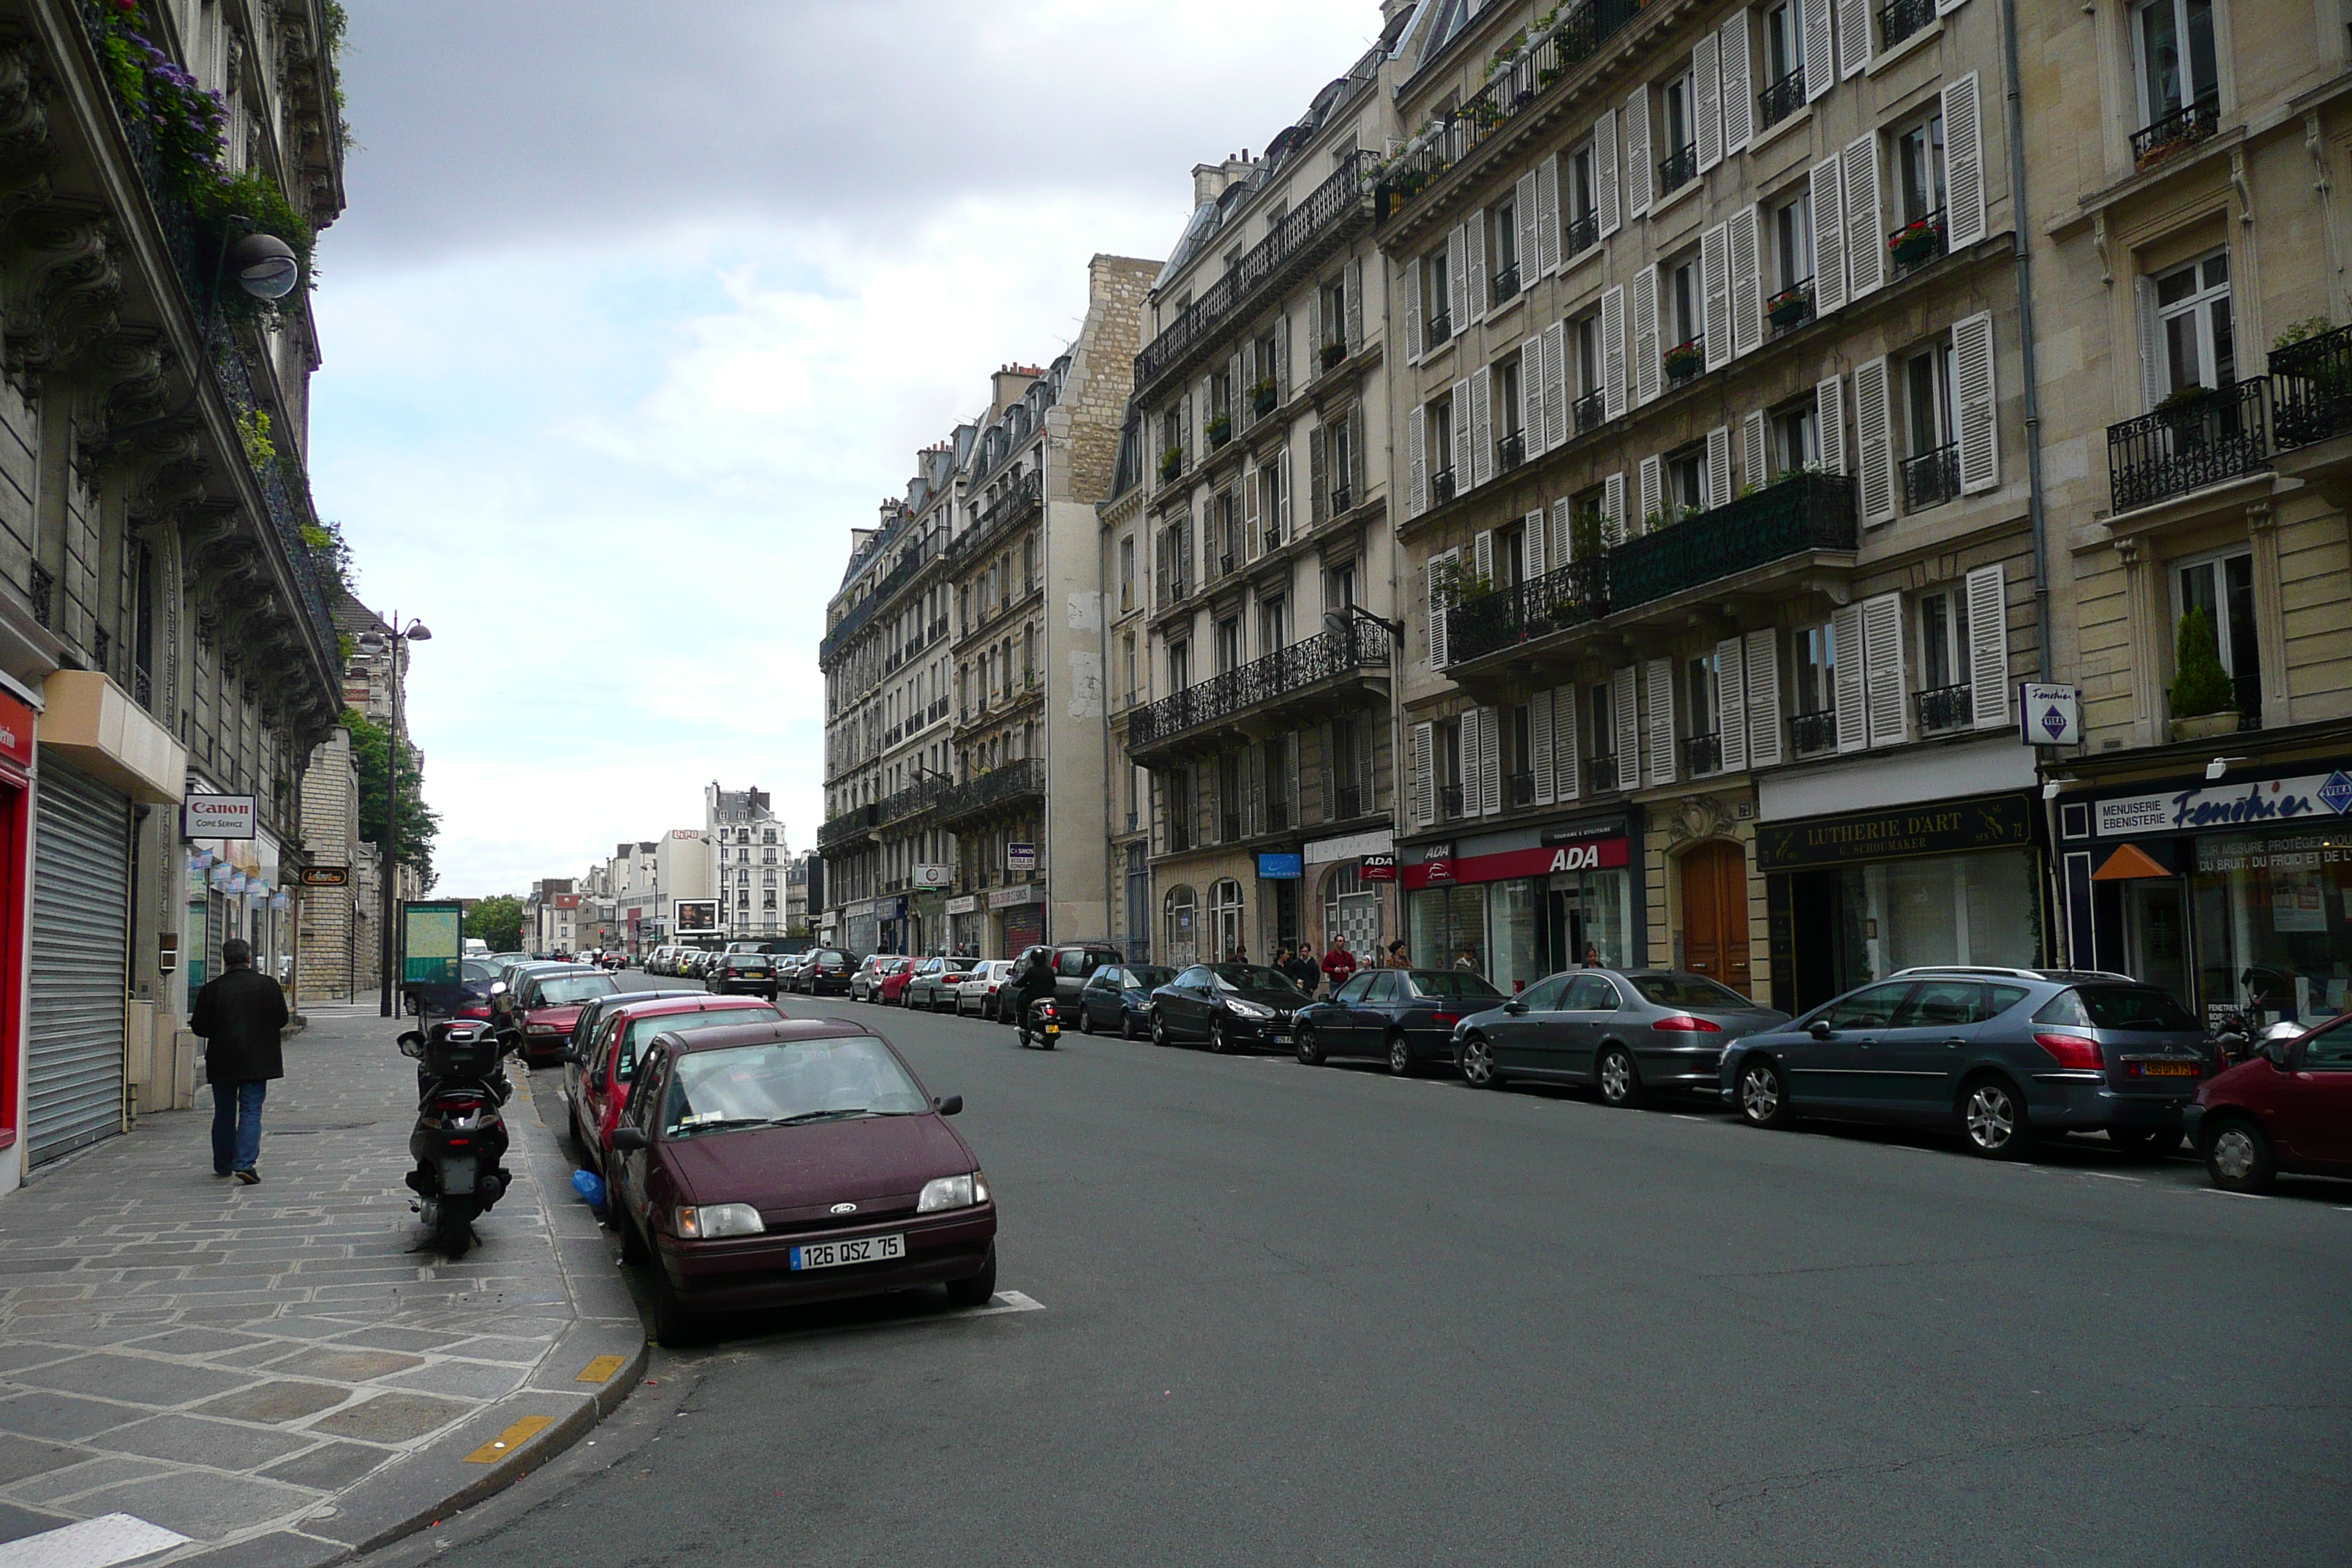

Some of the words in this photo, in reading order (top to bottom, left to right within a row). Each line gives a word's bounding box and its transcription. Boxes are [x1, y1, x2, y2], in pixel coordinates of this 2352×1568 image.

[2046, 717, 2062, 725] VEKA
[2326, 785, 2351, 796] VEKA
[192, 802, 249, 814] Canon
[2103, 800, 2162, 816] MENUISERIE
[218, 820, 243, 828] SERVICE
[2103, 813, 2166, 829] EBENISTERIE
[1583, 827, 1611, 835] UTILITAIRE
[1808, 819, 1900, 846] LUTHERIE
[1907, 812, 1962, 834] D'ART
[2013, 822, 2022, 837] 72
[1425, 844, 1450, 859] ADA
[1854, 837, 1926, 854] SCHOUMAKER
[2223, 841, 2264, 855] MESURE
[1365, 857, 1393, 865] ADA
[1550, 845, 1599, 872] ADA
[2200, 861, 2214, 872] DU
[2252, 856, 2266, 867] DU
[2271, 853, 2302, 866] FROID
[2306, 851, 2320, 864] ET
[2324, 851, 2339, 862] DE
[805, 1246, 834, 1266] 126
[840, 1241, 871, 1262] QSZ
[878, 1237, 898, 1256] 75
